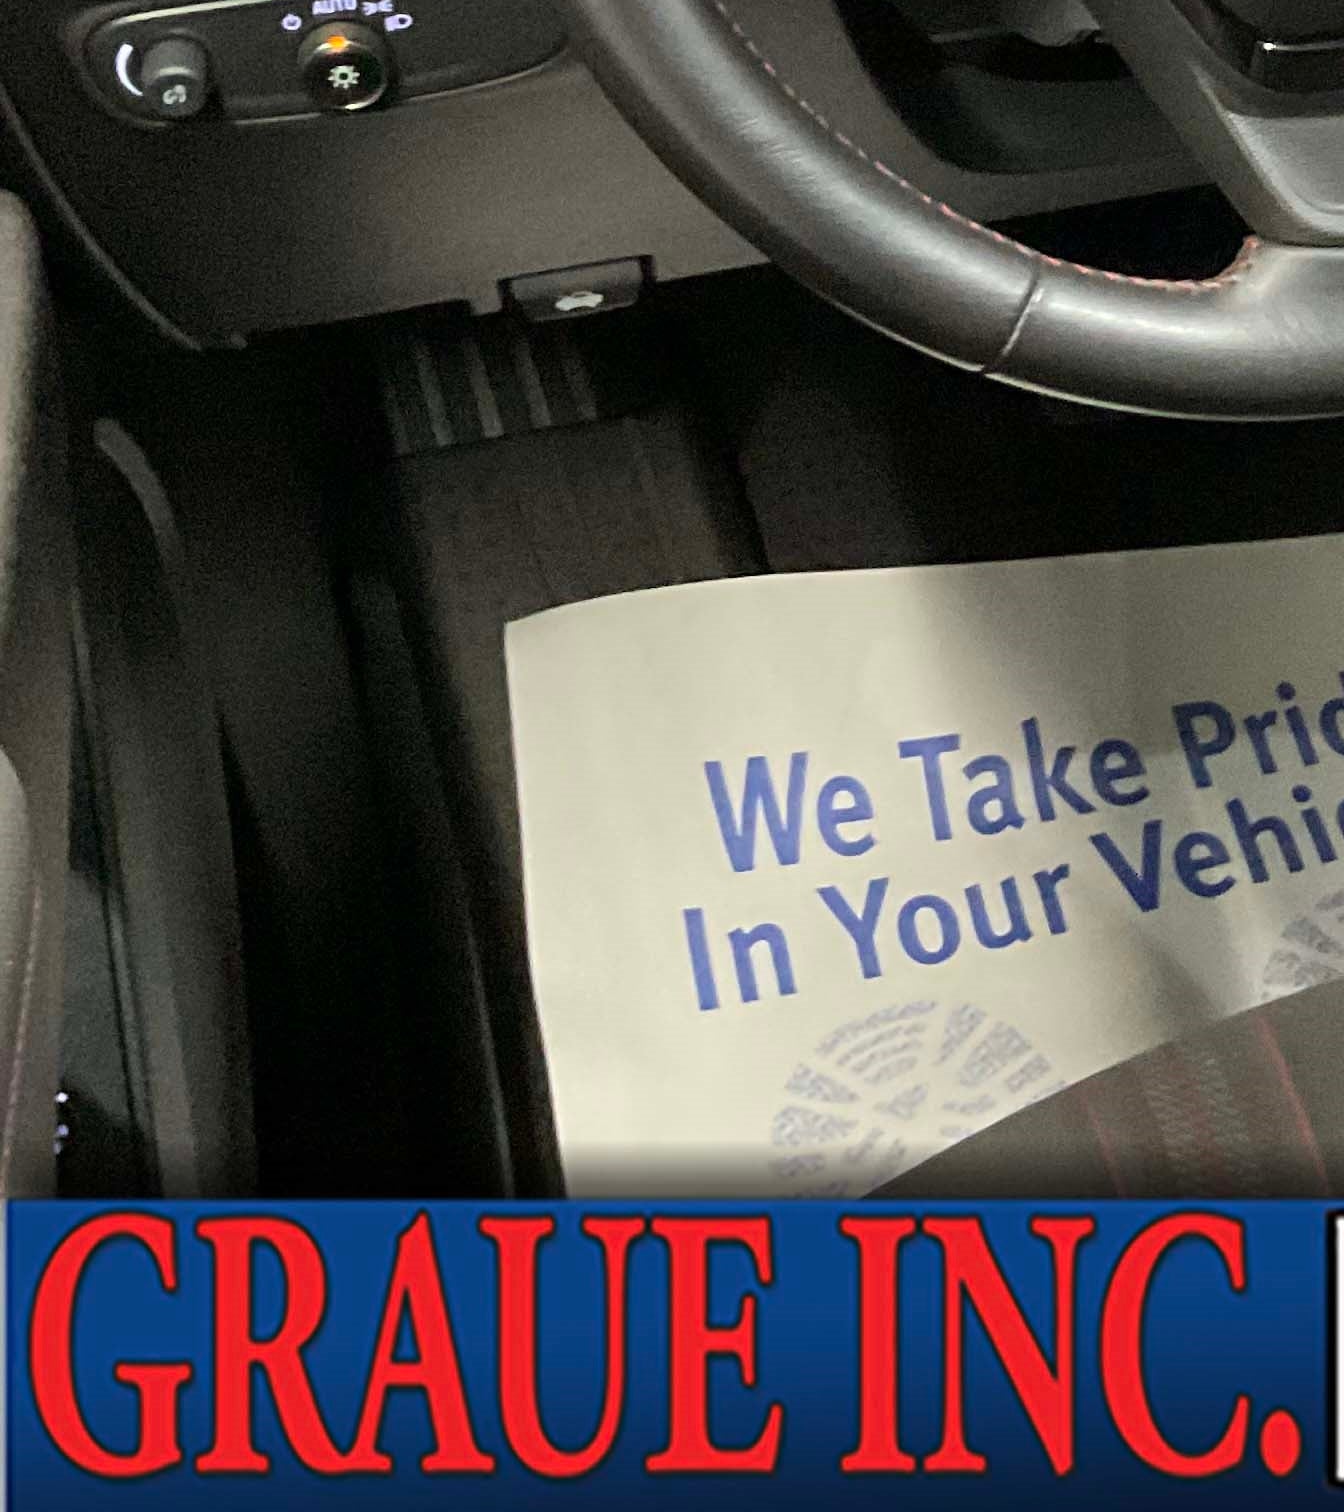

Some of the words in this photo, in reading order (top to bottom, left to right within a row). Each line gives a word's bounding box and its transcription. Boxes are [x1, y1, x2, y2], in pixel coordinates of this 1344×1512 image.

[704, 751, 875, 873] We
[898, 716, 1149, 842] Take
[682, 907, 798, 1011] In
[818, 860, 1071, 980] Your
